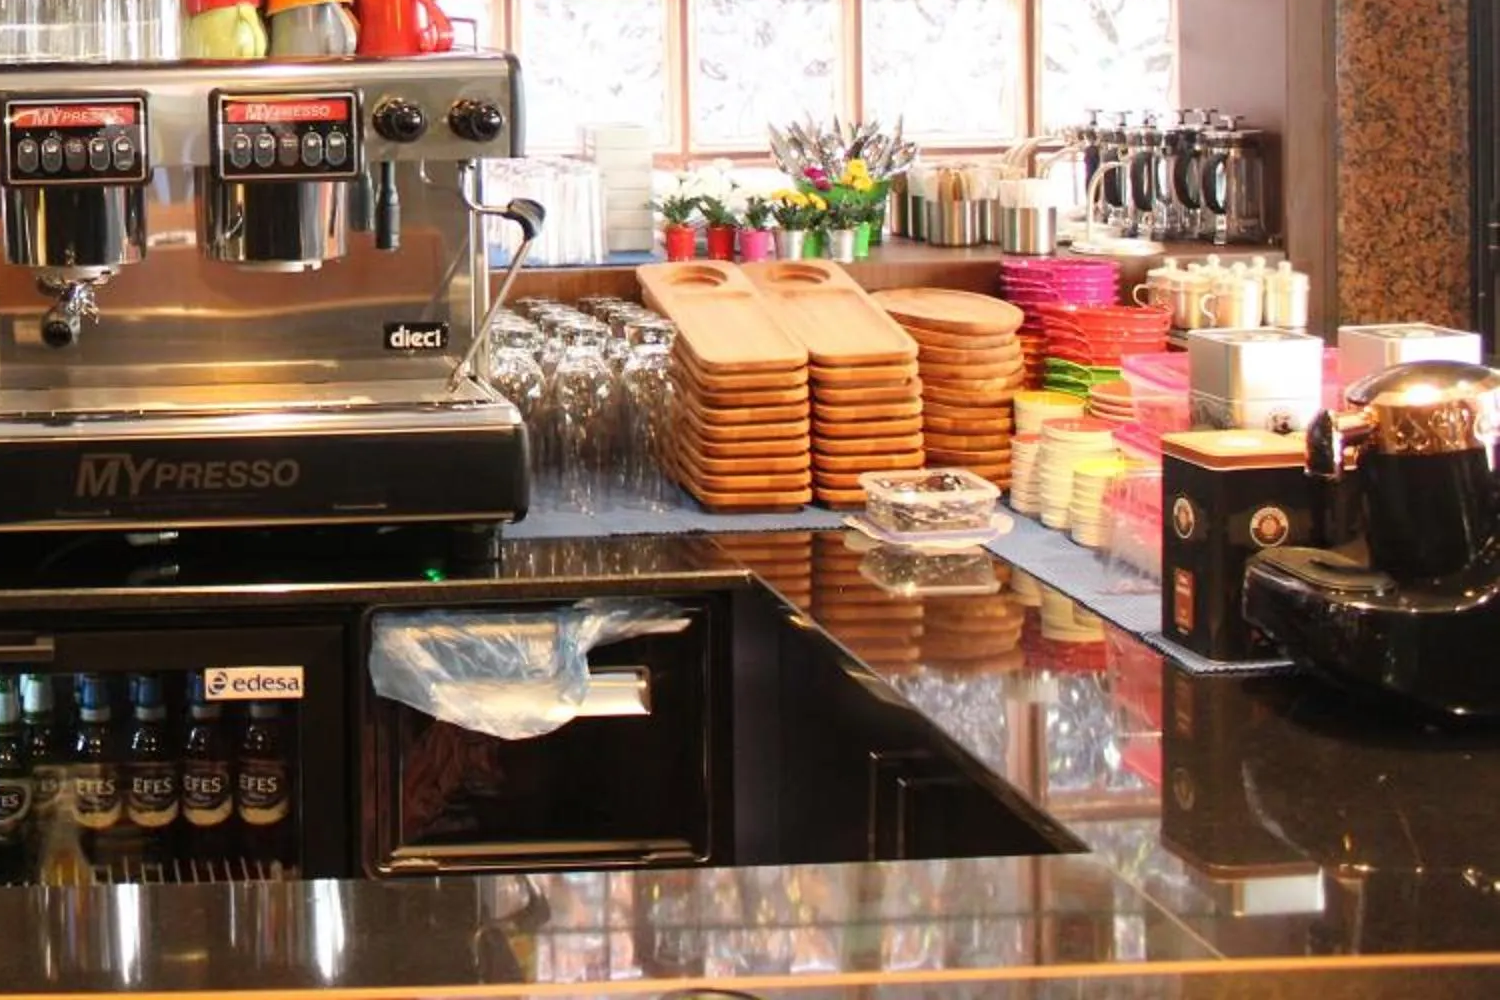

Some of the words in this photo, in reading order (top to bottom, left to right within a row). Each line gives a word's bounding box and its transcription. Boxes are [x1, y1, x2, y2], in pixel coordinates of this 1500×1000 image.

[390, 324, 441, 348] dieci
[74, 453, 300, 497] MYPRESSO
[233, 674, 299, 692] edesa
[76, 778, 116, 795] EFES
[132, 777, 173, 794] EFES
[183, 775, 221, 793] EFES
[239, 773, 278, 793] EFES
